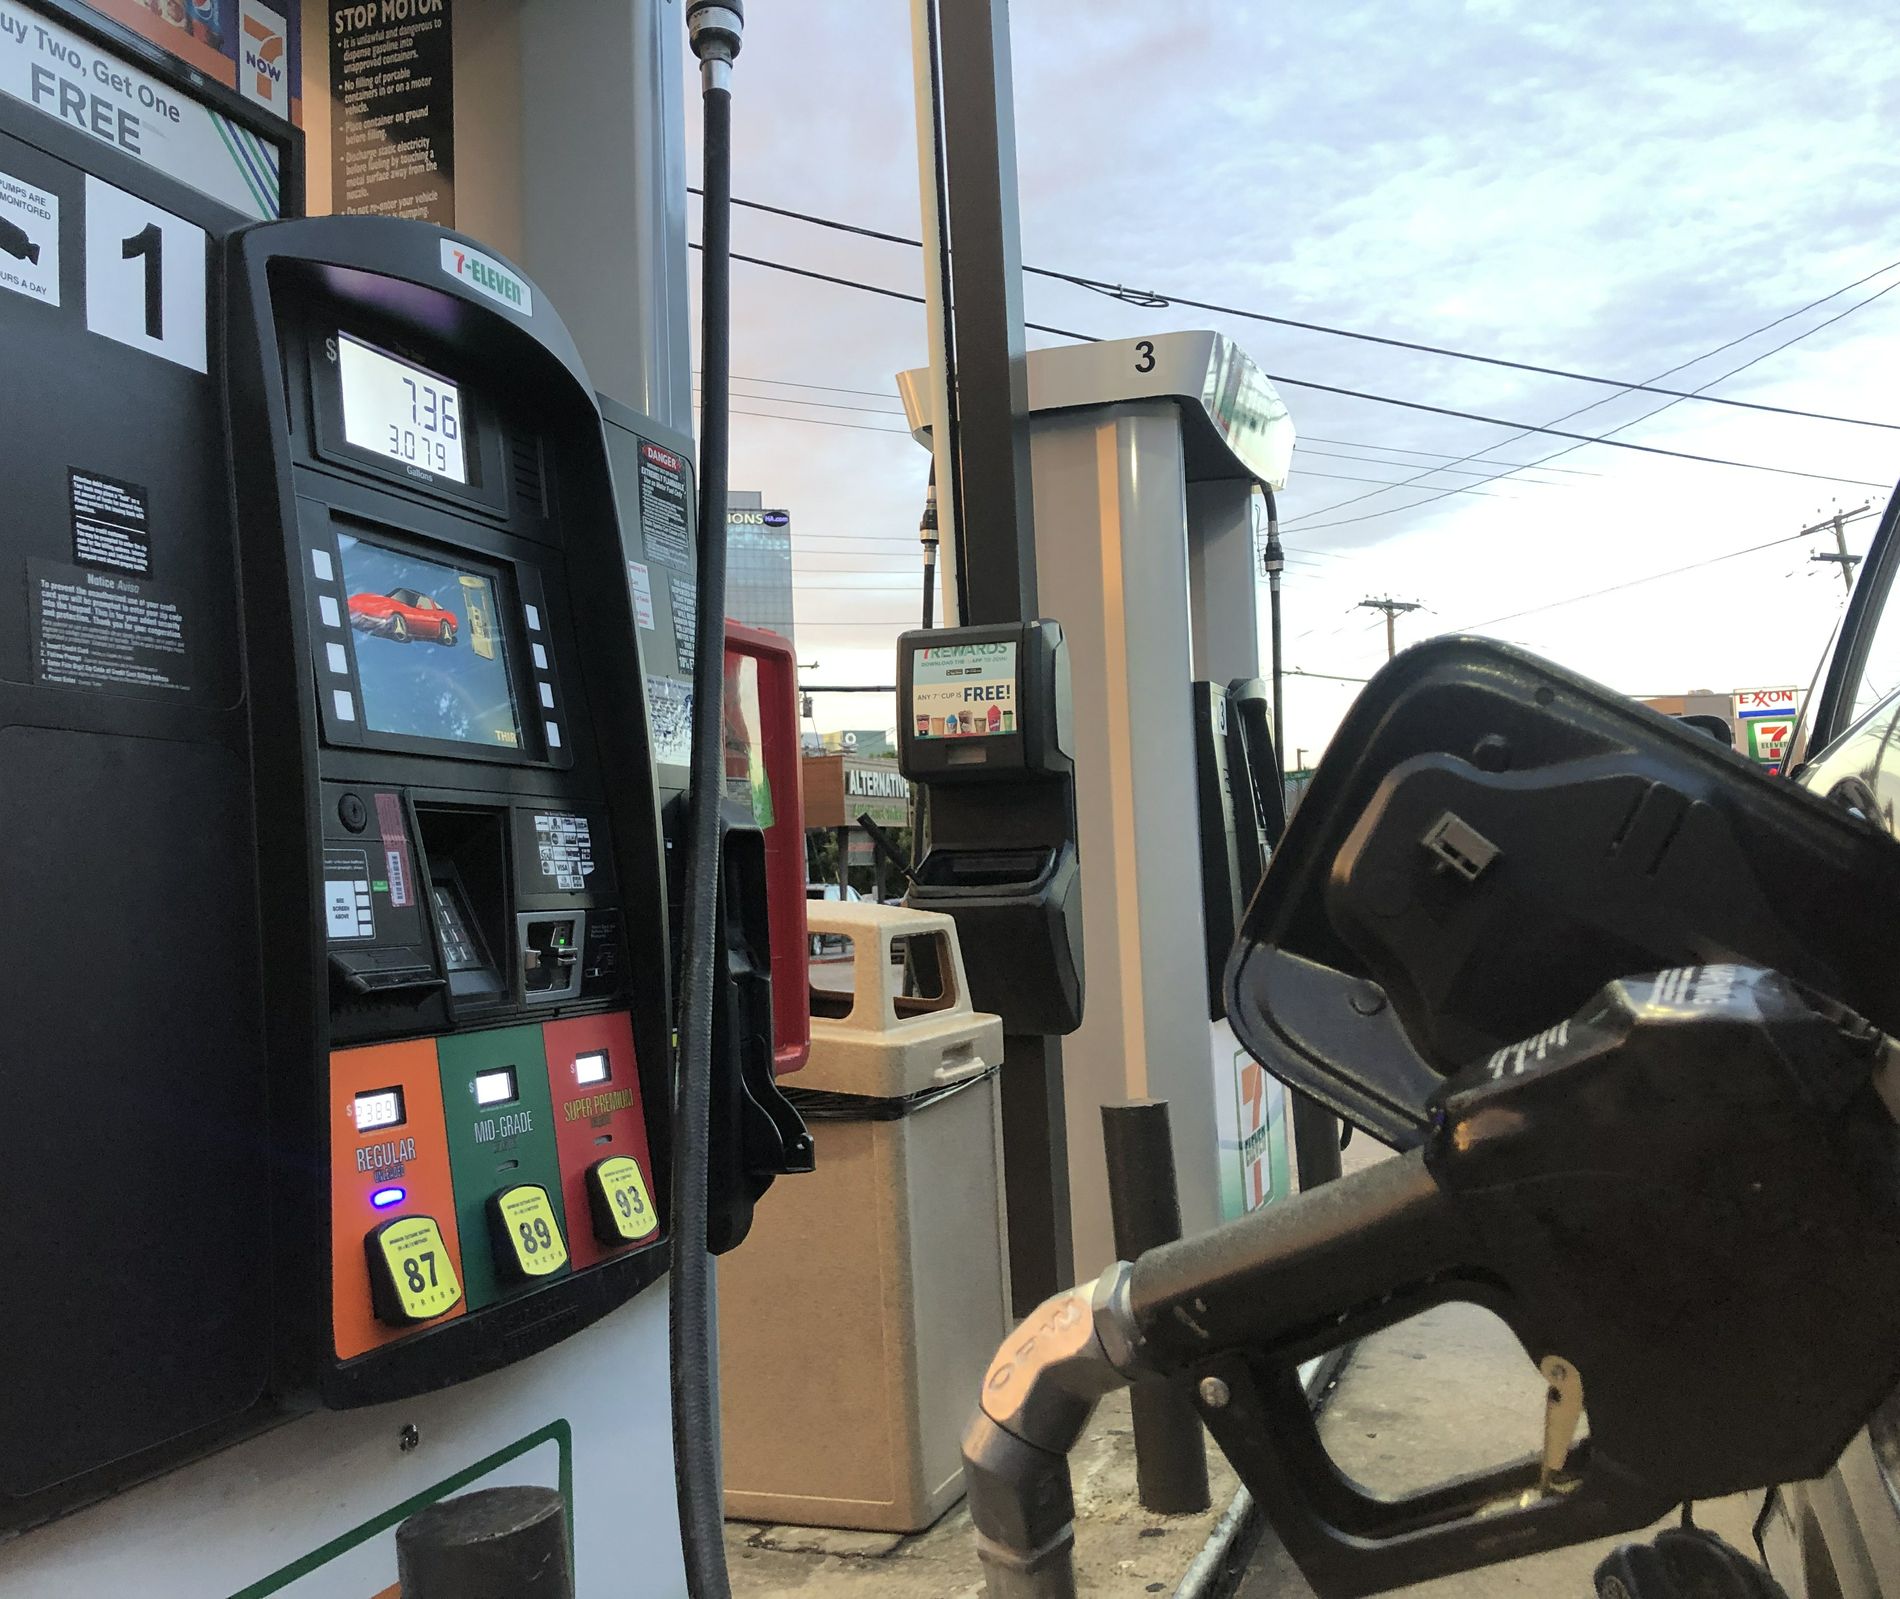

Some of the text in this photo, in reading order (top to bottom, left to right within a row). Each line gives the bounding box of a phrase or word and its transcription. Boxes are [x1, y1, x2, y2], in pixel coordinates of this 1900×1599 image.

[335, 2, 377, 34] STOP
[385, 27, 397, 38] and
[398, 21, 433, 36] dangerous
[434, 19, 441, 28] to
[372, 41, 398, 57] gasoline
[34, 25, 87, 77] Two,
[93, 60, 132, 98] Get
[138, 84, 180, 123] One
[246, 50, 281, 82] NOW
[344, 80, 354, 91] No
[374, 72, 381, 84] of
[386, 85, 394, 94] or
[395, 83, 404, 92] on
[405, 81, 409, 90] a
[410, 76, 432, 89] motor
[31, 62, 141, 155] FREE
[362, 114, 393, 129] container
[394, 112, 404, 121] on
[405, 104, 429, 123] ground
[397, 137, 429, 152] electricity
[426, 160, 437, 170] the
[0, 181, 46, 207] UMPS ARE
[0, 191, 51, 220] MONITORED
[0, 270, 47, 295] URS A DAY
[122, 222, 163, 341] 1
[325, 337, 337, 364] $
[1135, 341, 1156, 373] 3
[402, 377, 457, 441] 7.36
[389, 424, 446, 472] 3.079
[647, 447, 677, 469] DANGER
[407, 465, 433, 482] Gallons
[87, 573, 139, 593] Notice Aviso
[964, 684, 1010, 702] FREE!
[1739, 690, 1793, 707] EXXON
[1219, 700, 1226, 731] 3
[849, 769, 909, 798] ALTERNATIVE
[556, 863, 568, 872] VISA
[469, 1081, 475, 1094] $
[346, 1104, 353, 1118] $
[563, 1097, 593, 1122] SUPER
[594, 1088, 634, 1115] PREMIUM
[474, 1110, 534, 1144] MID-GRADE
[356, 1137, 416, 1172] REGULAR
[615, 1185, 645, 1218] 93
[519, 1217, 552, 1255] 89
[403, 1251, 438, 1293] 87
